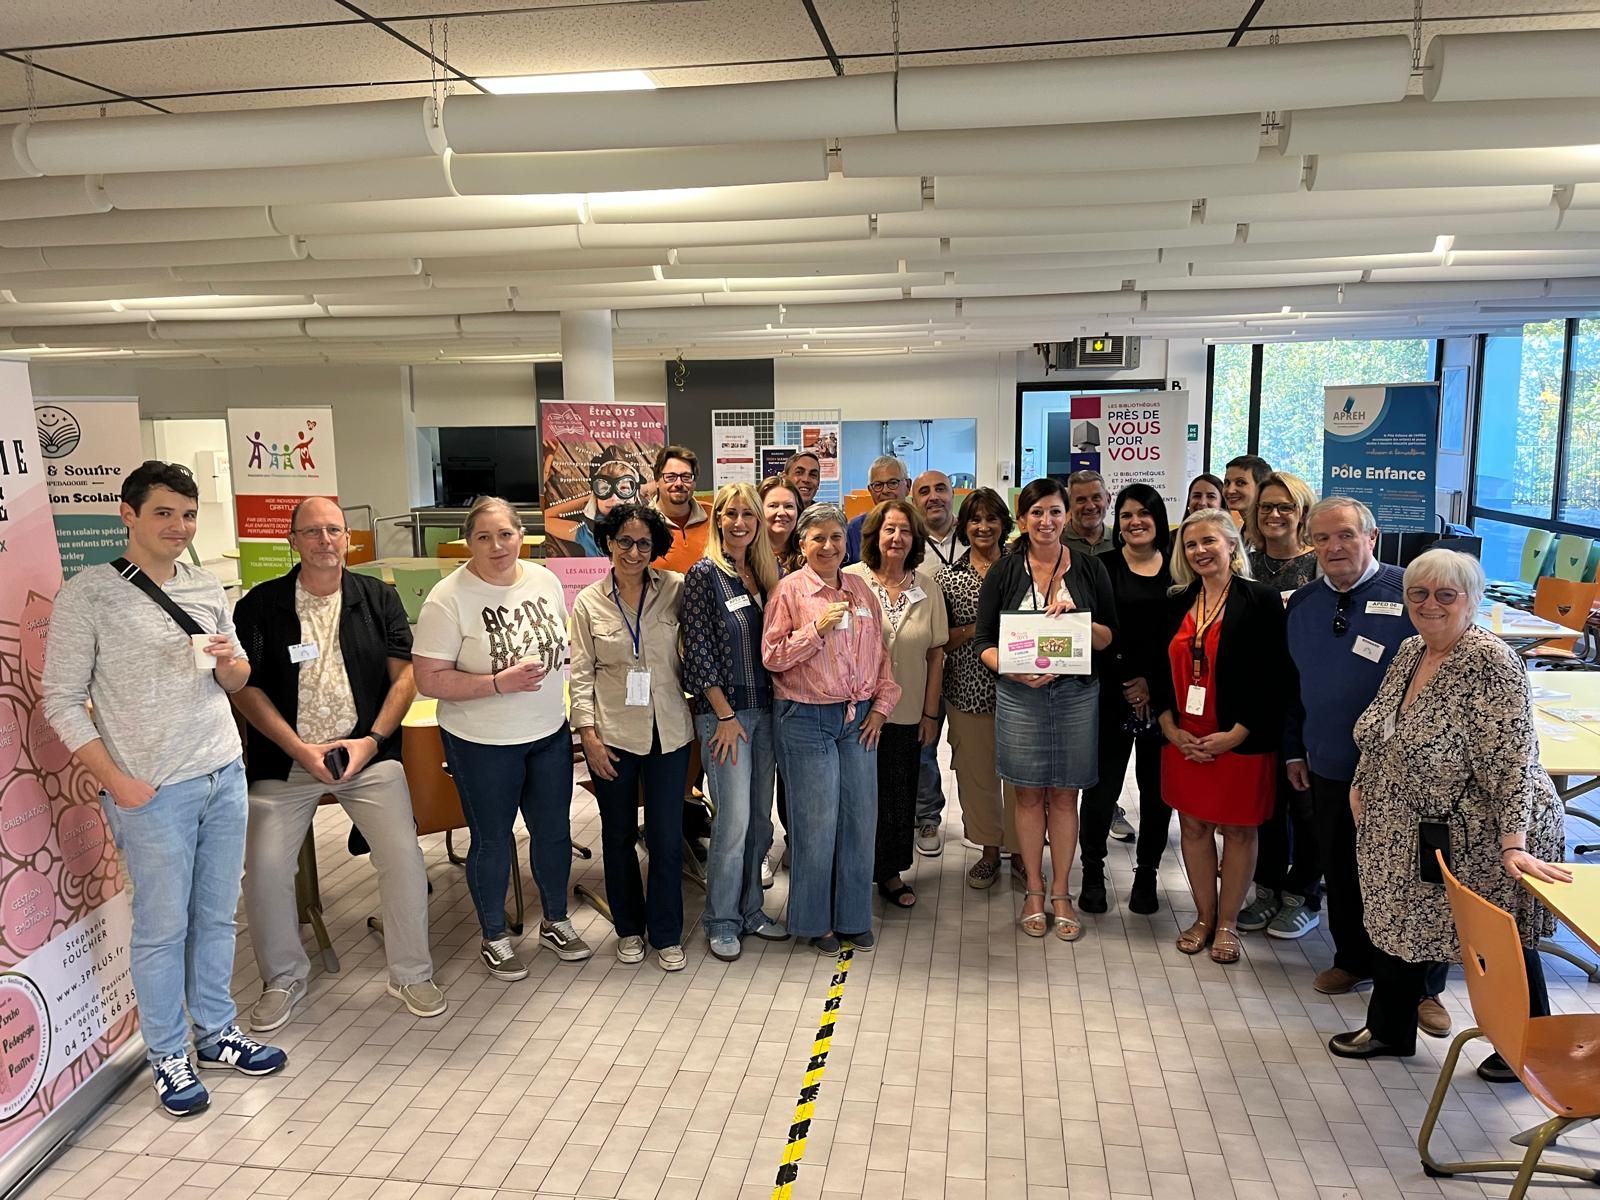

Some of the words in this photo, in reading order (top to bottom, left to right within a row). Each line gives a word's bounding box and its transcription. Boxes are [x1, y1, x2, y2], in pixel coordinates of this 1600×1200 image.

[589, 406, 612, 416] Être
[615, 408, 635, 417] DYS
[1108, 409, 1139, 420] PRÈS
[1143, 410, 1160, 419] DE
[1333, 411, 1366, 421] APREH
[589, 420, 616, 428] n'est
[620, 421, 638, 430] pas
[1108, 421, 1161, 435] VOUS
[589, 430, 631, 439] fatalité
[634, 431, 641, 439] !!
[1108, 436, 1143, 445] POUR
[1108, 447, 1161, 461] VOUS
[47, 465, 58, 476] &
[64, 464, 121, 476] Sourire
[1331, 463, 1362, 479] Pôle
[1366, 466, 1427, 481] Enfance
[73, 492, 123, 503] Scolair
[72, 528, 100, 536] scolaire
[72, 540, 100, 548] enfants
[3, 803, 49, 831] ORIENTATION
[11, 887, 42, 910] GESTION
[23, 903, 37, 917] DES
[15, 908, 50, 935] EMOTIONS
[65, 917, 107, 952] Stéphanie
[62, 929, 108, 969] FOUCHIER
[55, 946, 124, 1003] www.3PPLUS.fr
[64, 1002, 89, 1026] avenue
[91, 993, 100, 1004] de
[78, 1005, 99, 1027] 06100
[100, 989, 119, 1010] NICE
[64, 1039, 78, 1057] 04
[81, 1026, 93, 1043] 22
[96, 1016, 108, 1030] 16
[111, 1001, 122, 1016] 66
[125, 988, 136, 1005] 35
[2, 1023, 36, 1055] Pédagogie
[8, 1052, 36, 1079] Positive
